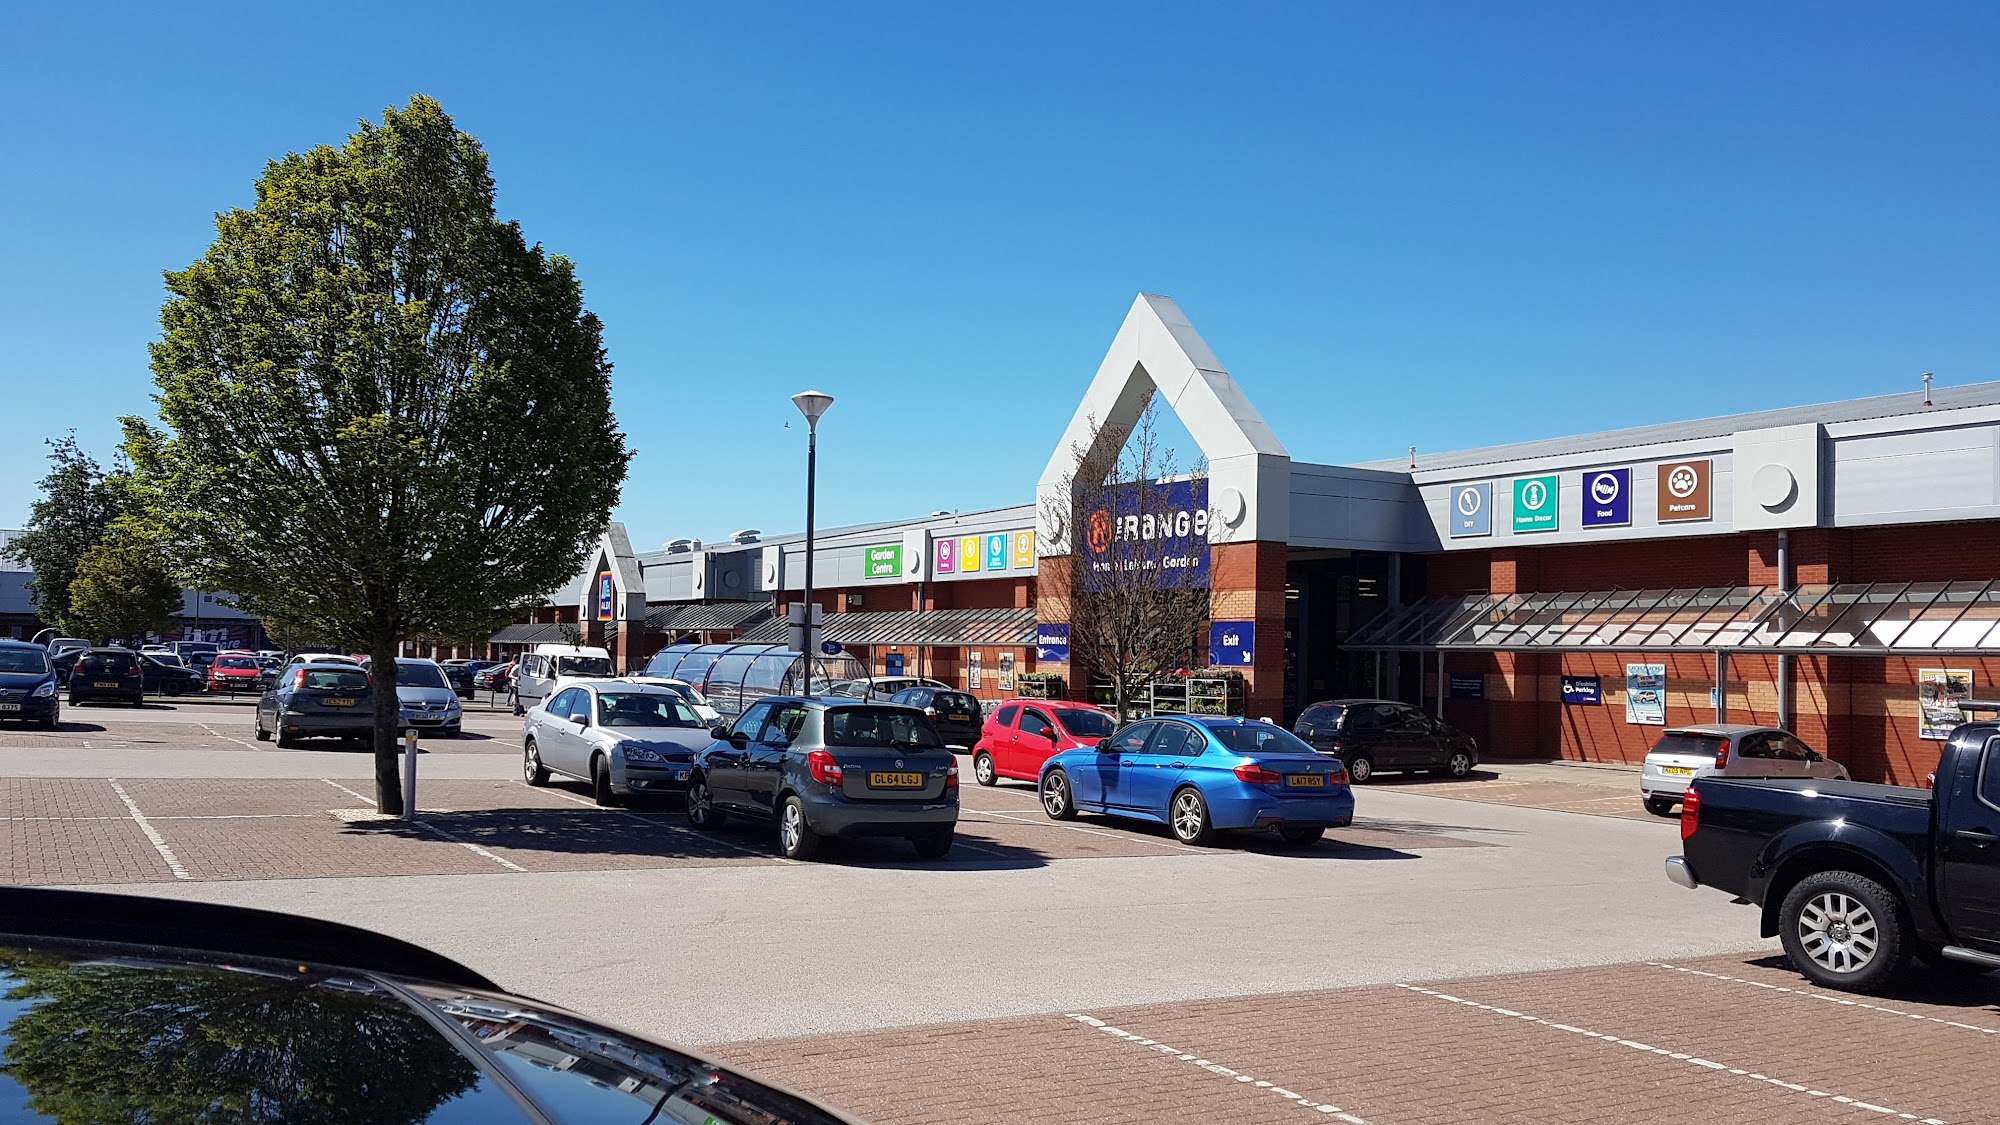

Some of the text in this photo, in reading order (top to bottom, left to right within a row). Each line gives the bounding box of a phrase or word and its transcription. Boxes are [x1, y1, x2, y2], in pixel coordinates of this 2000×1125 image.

[1669, 504, 1696, 512] Petcare
[1597, 509, 1613, 517] Food
[1534, 514, 1552, 522] Decor
[871, 548, 895, 561] Garden
[872, 562, 893, 575] Centre
[1039, 635, 1067, 645] Entrance
[1223, 634, 1240, 646] Exit
[1575, 686, 1595, 695] Parking
[874, 774, 919, 785] GL64 LGJ
[1291, 777, 1321, 786] LA17 RSY
